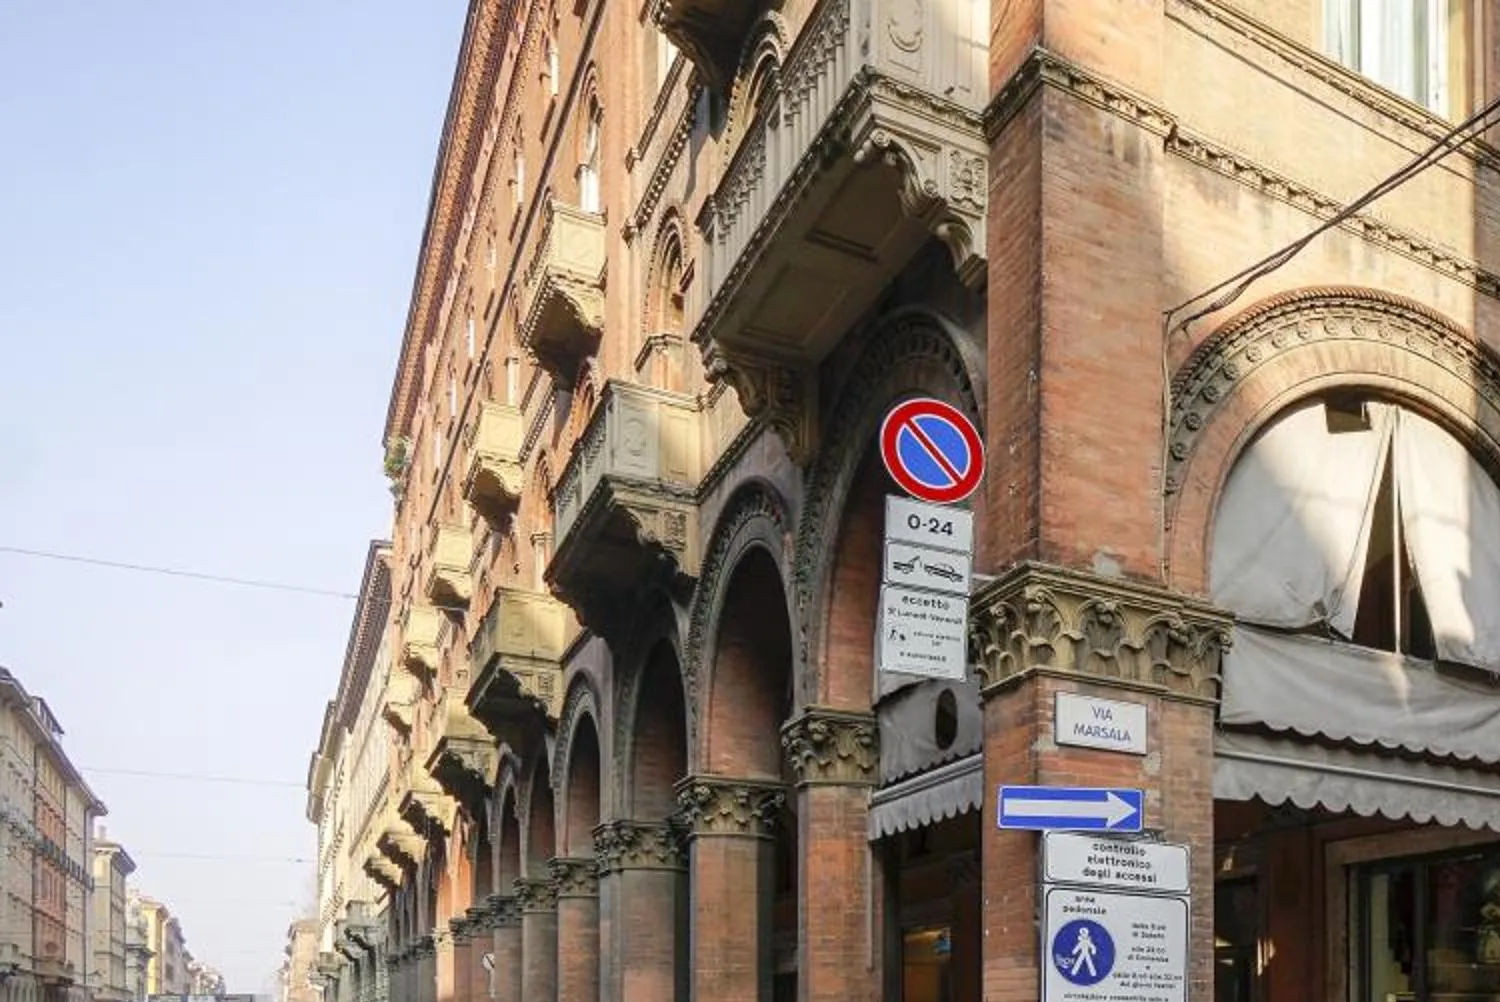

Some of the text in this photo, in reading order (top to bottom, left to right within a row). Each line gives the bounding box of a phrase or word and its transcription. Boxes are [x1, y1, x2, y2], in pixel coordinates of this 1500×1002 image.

[907, 513, 953, 536] 0-24
[902, 596, 951, 610] eccetto
[1090, 704, 1112, 721] VIA
[1074, 723, 1131, 741] MARSALA
[1092, 843, 1146, 856] controllo
[1087, 854, 1152, 869] elettronico
[1082, 866, 1157, 884] degli accessi
